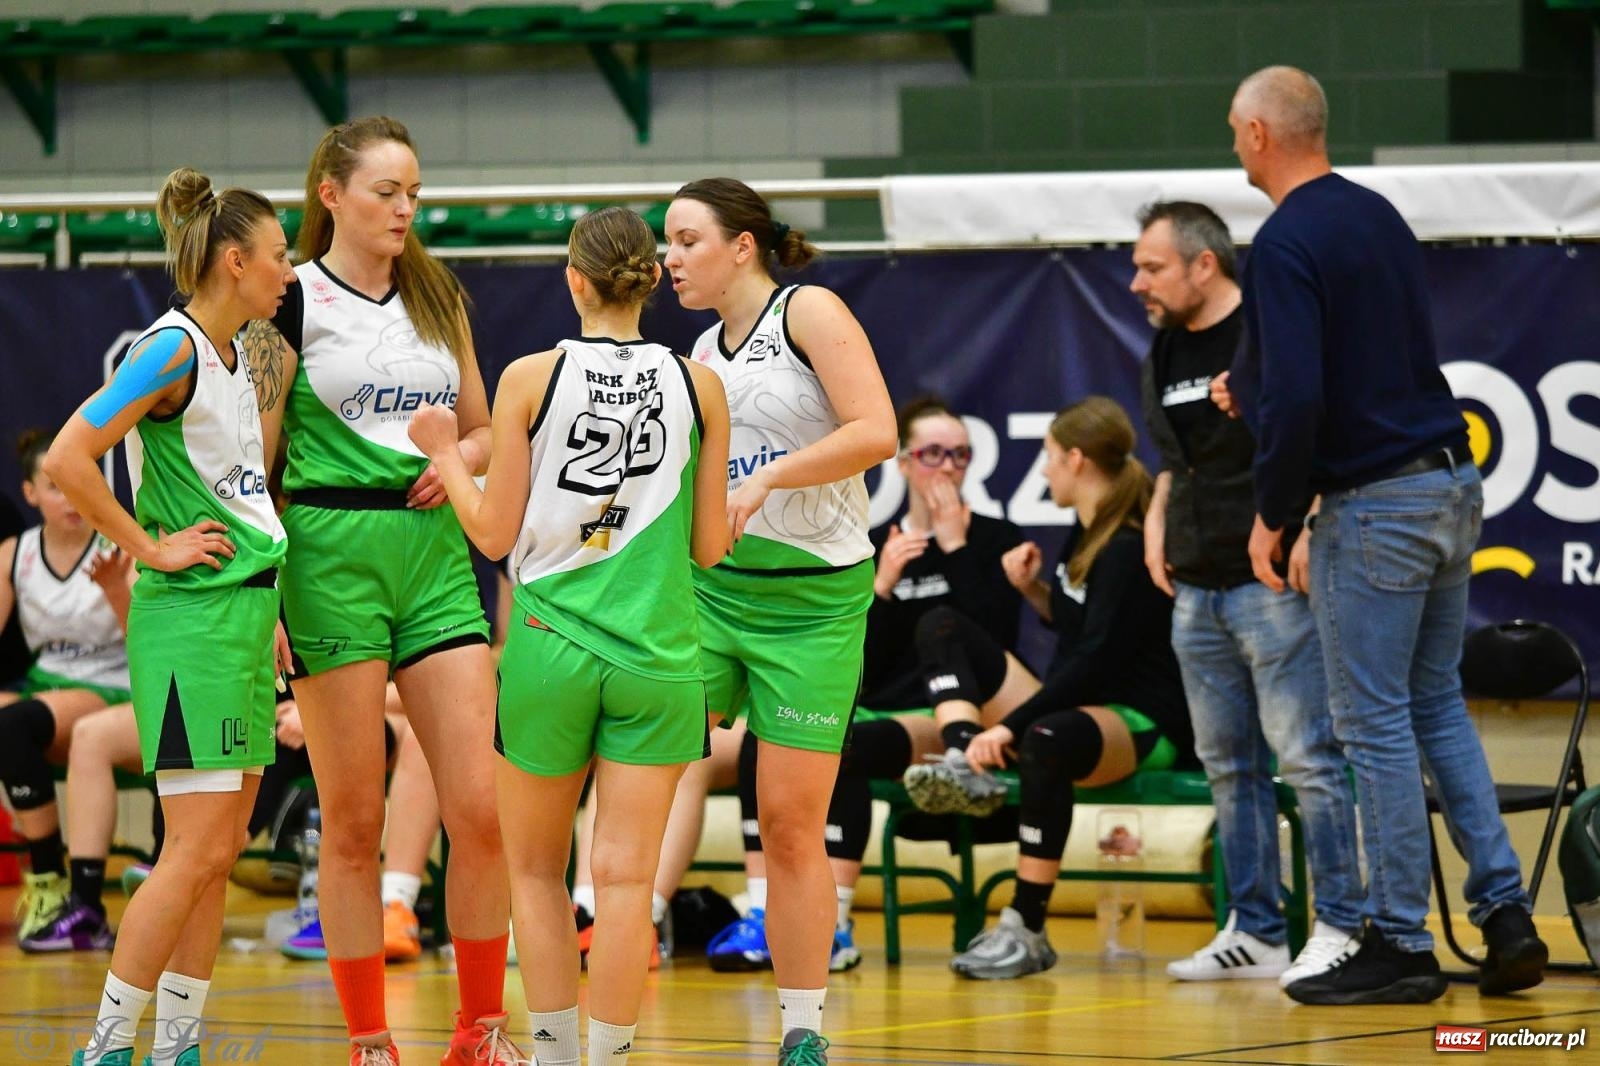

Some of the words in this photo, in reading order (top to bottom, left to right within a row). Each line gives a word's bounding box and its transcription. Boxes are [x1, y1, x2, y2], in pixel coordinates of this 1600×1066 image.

[745, 328, 781, 364] 24
[585, 369, 624, 388] RKK
[727, 445, 788, 481] avi
[240, 469, 266, 496] Cla
